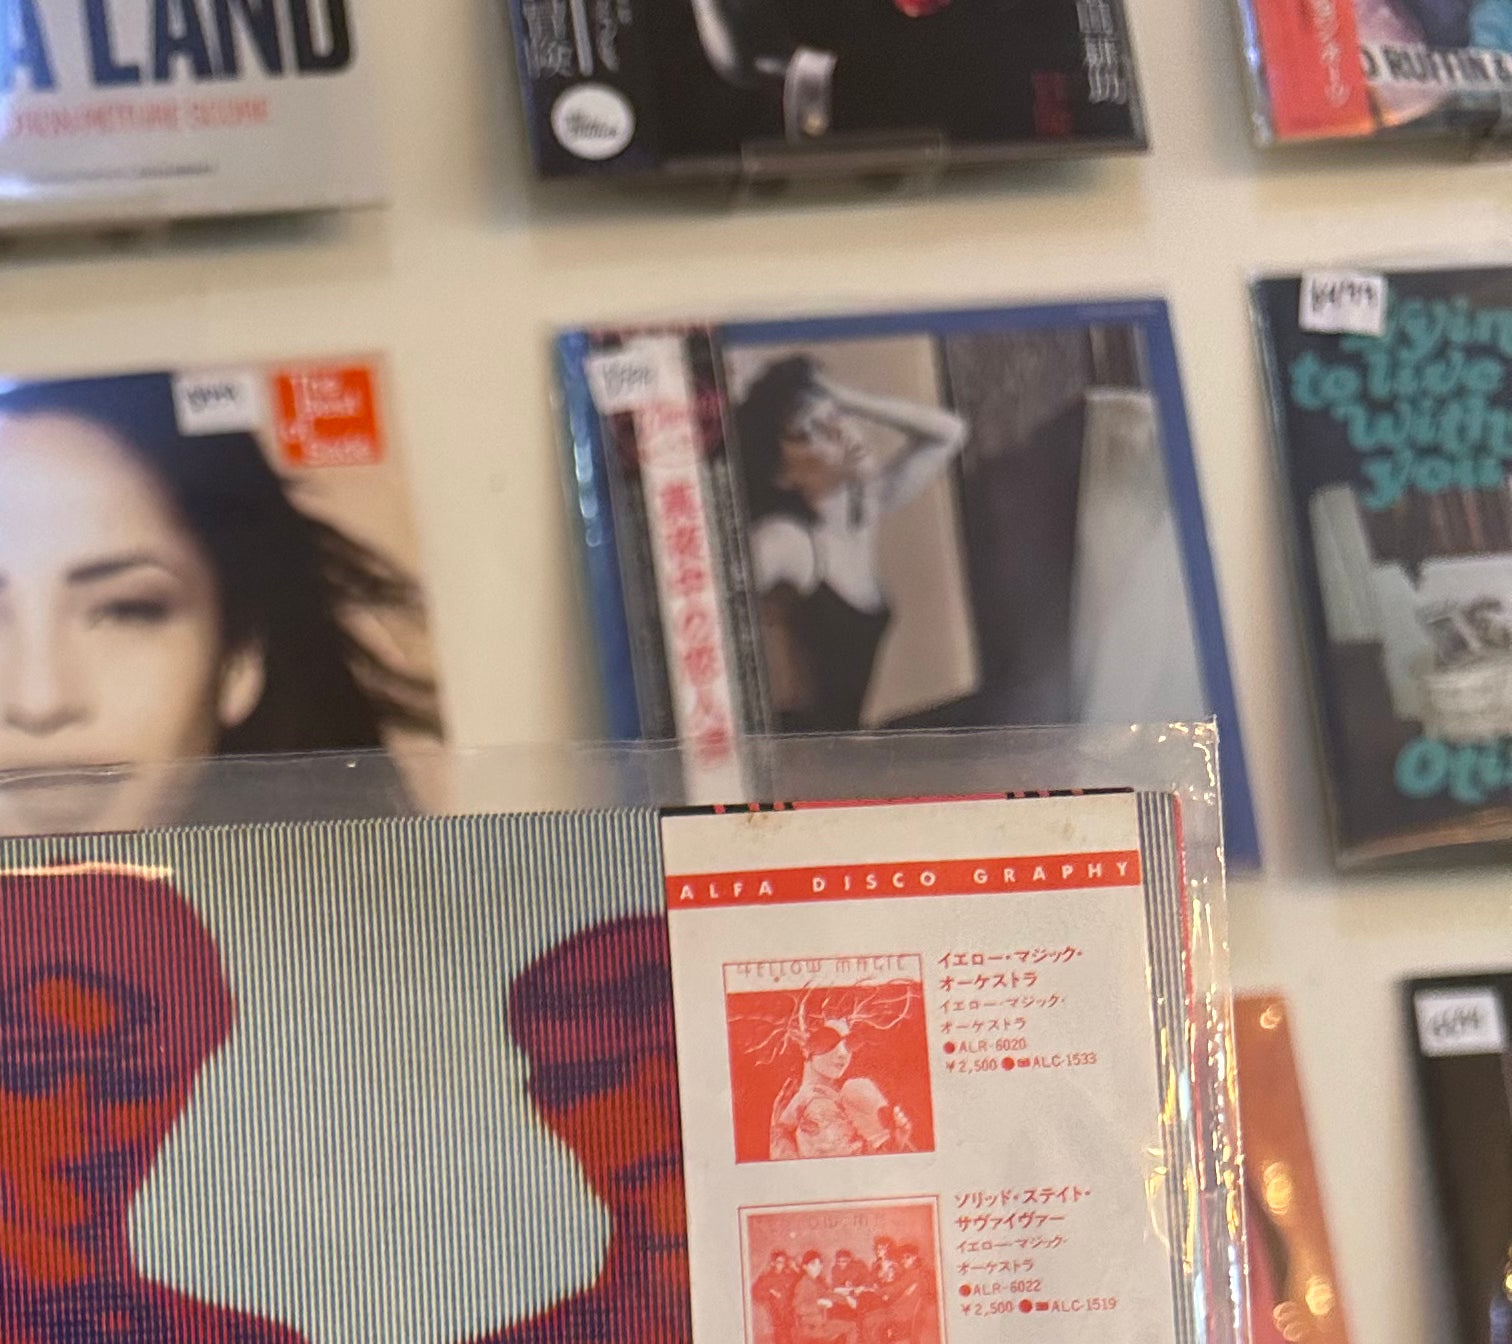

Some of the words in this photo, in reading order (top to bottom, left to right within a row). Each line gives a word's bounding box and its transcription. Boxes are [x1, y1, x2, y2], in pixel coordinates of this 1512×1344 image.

[81, 0, 355, 89] LAND
[679, 879, 774, 900] ALFA
[812, 869, 937, 893] DISCO
[973, 861, 1130, 884] GRAPHY
[940, 971, 1037, 992] オーケストラ
[940, 1017, 1026, 1033] オーケストラ
[957, 1259, 1033, 1274] オーケストラ
